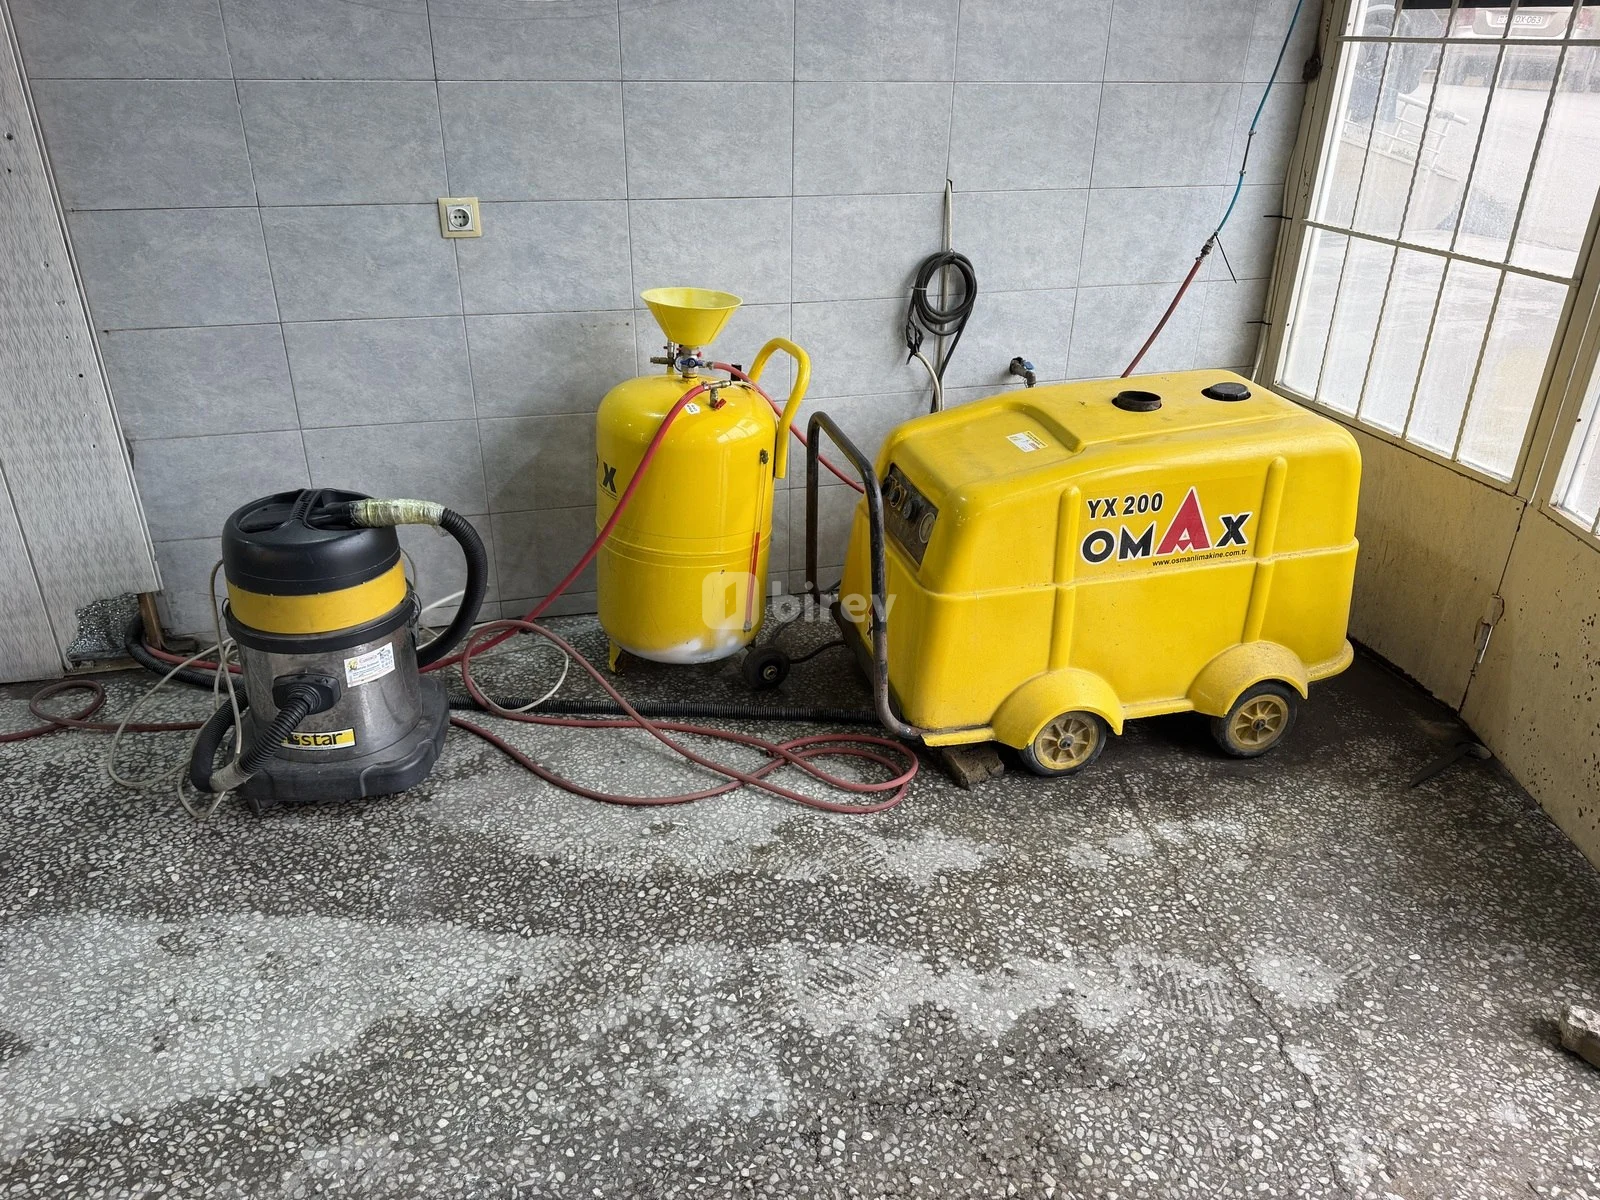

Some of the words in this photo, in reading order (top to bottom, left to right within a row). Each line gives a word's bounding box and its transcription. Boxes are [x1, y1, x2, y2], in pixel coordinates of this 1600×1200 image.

[1087, 497, 1118, 519] YX
[1122, 492, 1163, 516] 200
[1081, 487, 1251, 564] OMAX
[1152, 549, 1248, 567] www.osmanlimakine.com.tr
